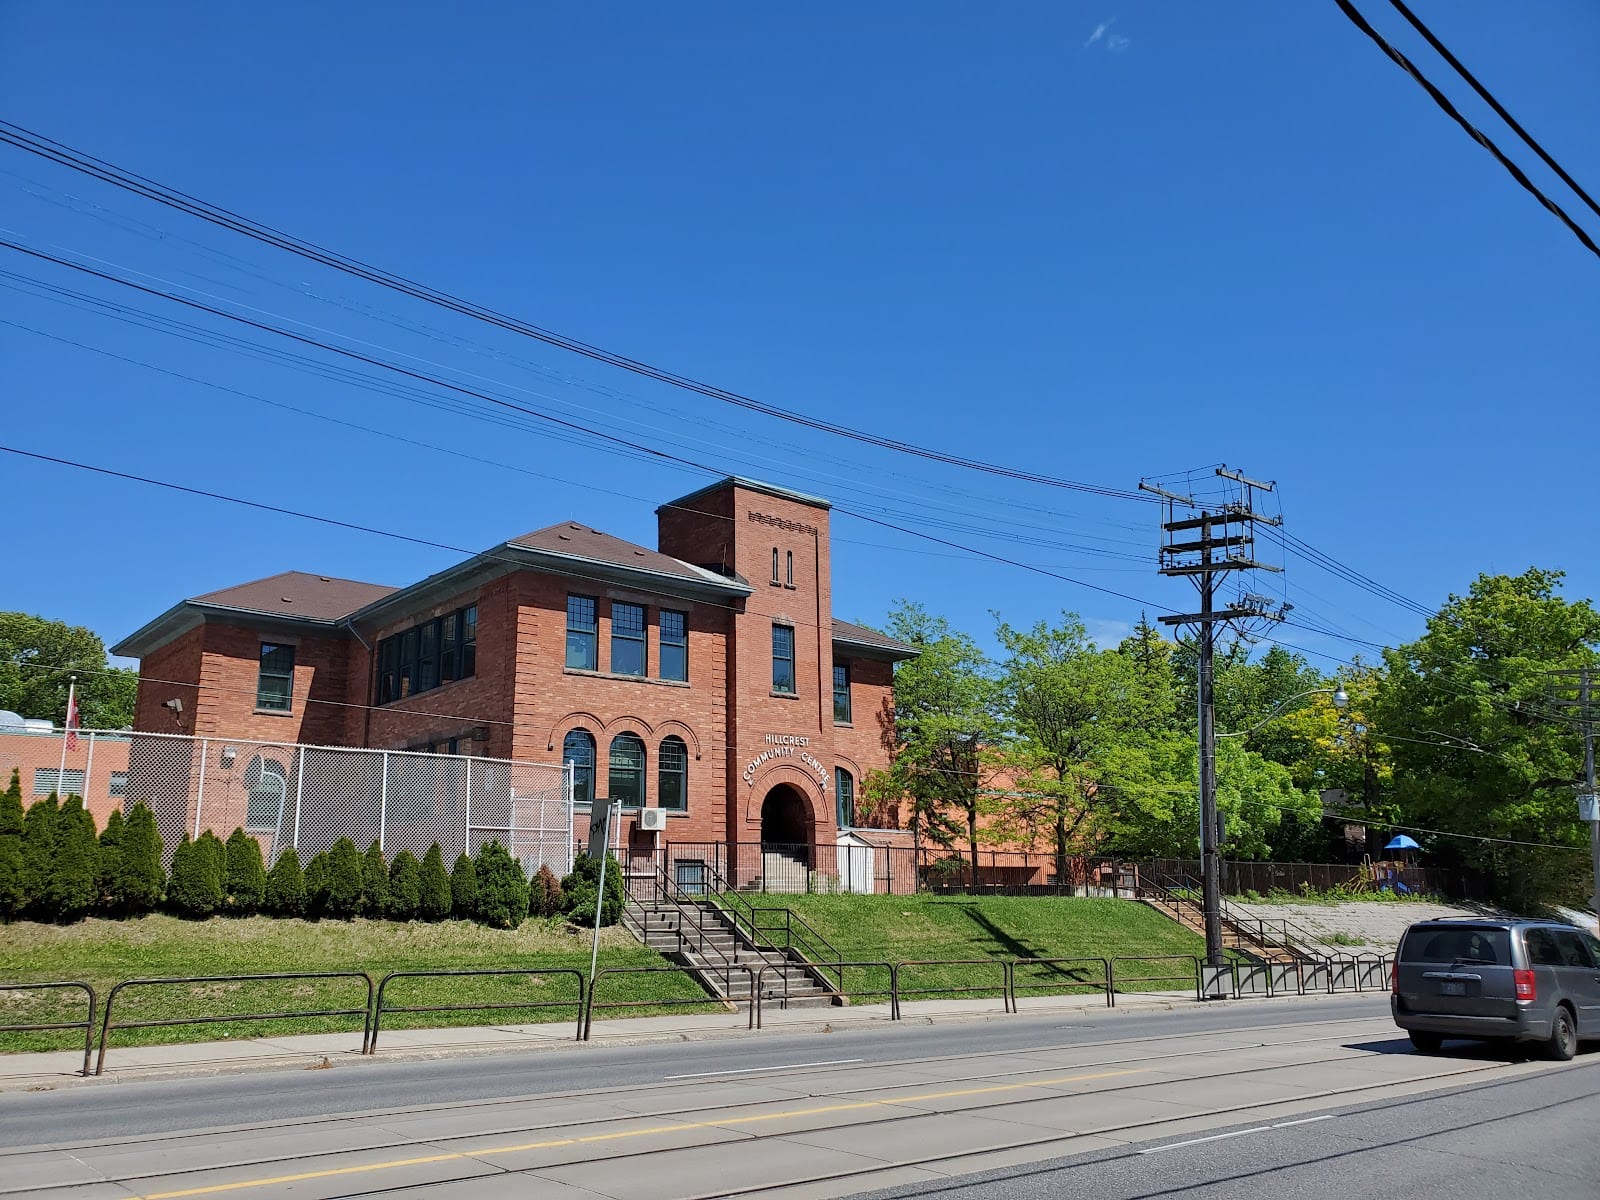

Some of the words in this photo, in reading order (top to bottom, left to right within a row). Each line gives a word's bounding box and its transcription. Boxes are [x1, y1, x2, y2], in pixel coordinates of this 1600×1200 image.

[765, 734, 810, 746] HILLCREST
[743, 747, 794, 780] COMMUNITY
[801, 752, 830, 783] CENTRE
